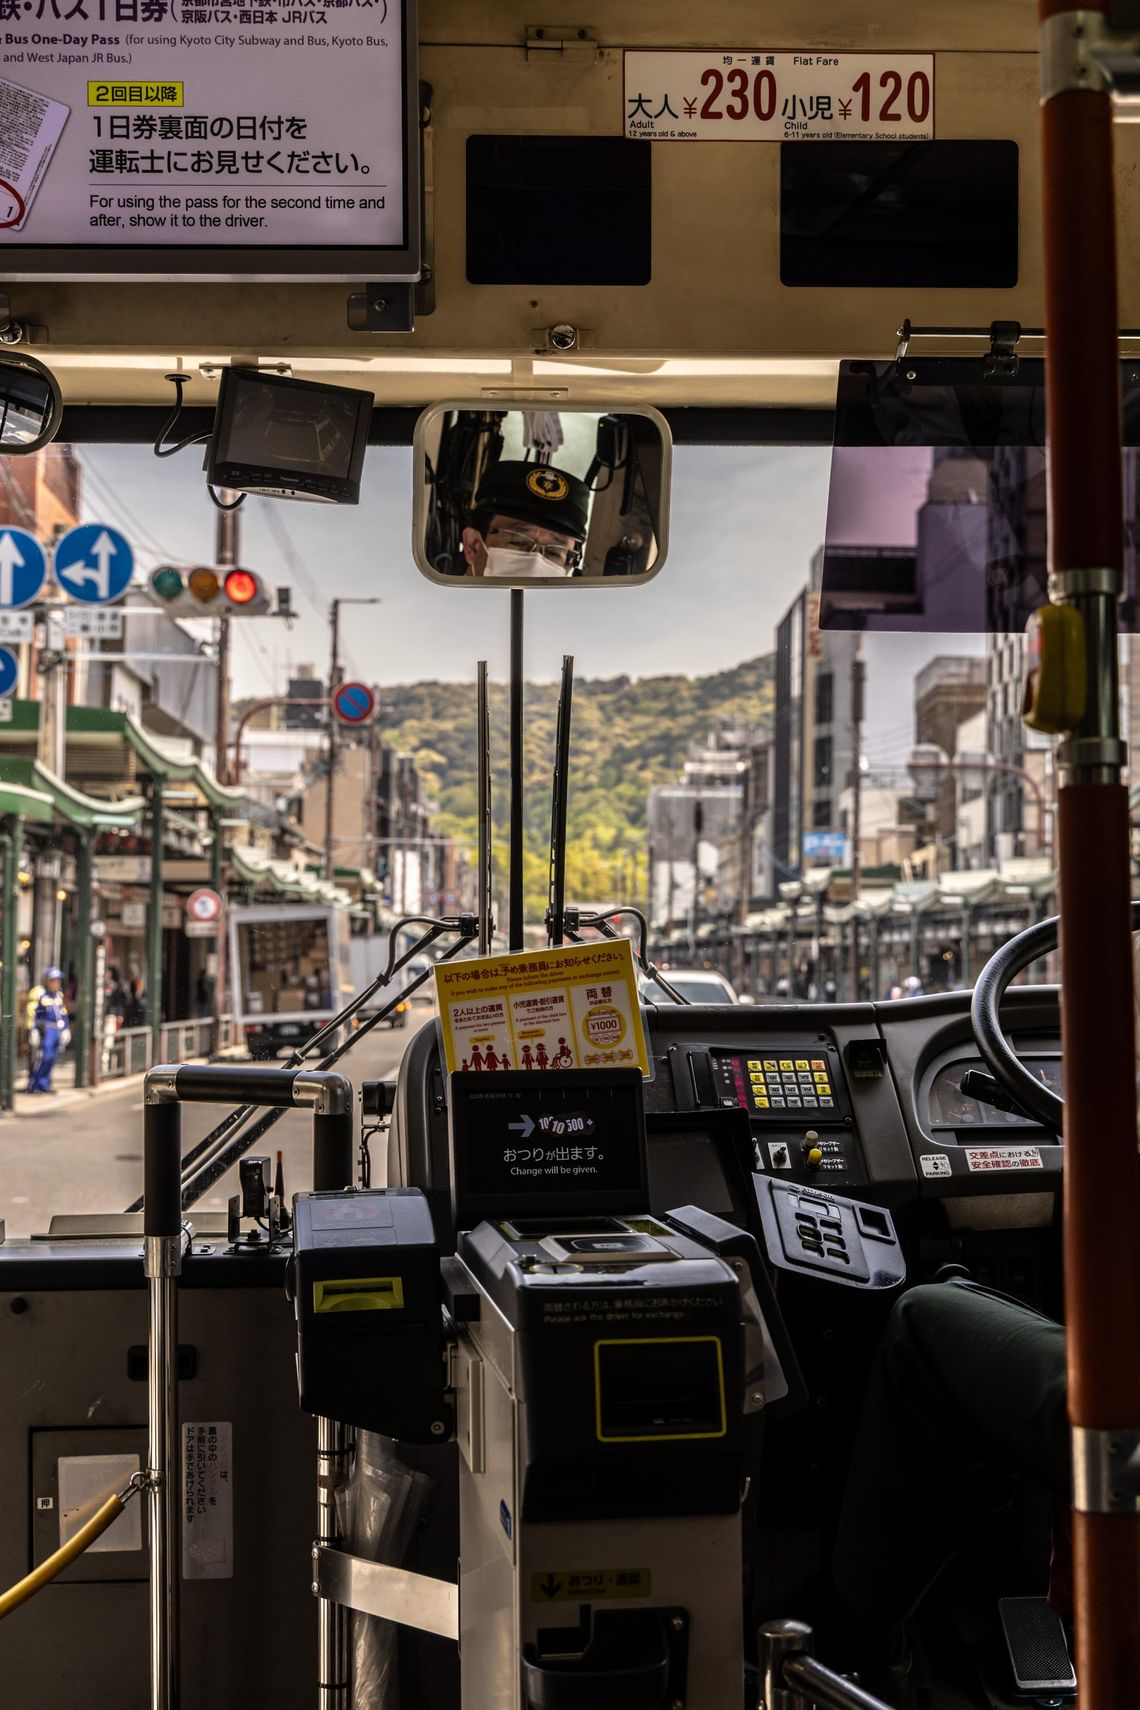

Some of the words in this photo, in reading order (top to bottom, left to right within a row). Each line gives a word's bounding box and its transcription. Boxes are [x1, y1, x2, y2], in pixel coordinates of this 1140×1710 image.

[181, 10, 277, 24] 京阪バス・西日本
[282, 11, 327, 24] JRバス
[5, 34, 28, 45] Bus
[31, 34, 88, 47] One-Day
[91, 34, 120, 45] Pass
[125, 34, 144, 47] (for
[147, 35, 177, 47] using
[180, 35, 212, 47] Kyoto
[214, 35, 235, 47] City
[238, 35, 280, 48] Subway
[283, 35, 305, 46] and
[307, 36, 330, 47] Bus,
[332, 36, 364, 48] Kyoto
[366, 36, 389, 47] Bus,
[3, 52, 24, 63] and
[27, 53, 54, 63] West
[56, 53, 89, 65] Japan
[91, 53, 104, 63] JR
[106, 53, 133, 64] Bus.)
[794, 56, 813, 66] Flat
[816, 56, 839, 66] Fare
[95, 85, 178, 103] 2回目以降
[628, 93, 679, 120] 大人
[781, 94, 833, 120] 小児
[92, 114, 308, 141] 1日券裏面の日付を
[630, 120, 655, 129] Adult
[784, 121, 808, 130] Child
[89, 149, 371, 175] 運転士にお見せください。
[90, 195, 115, 209] For
[117, 195, 155, 213] using
[158, 195, 181, 209] the
[185, 197, 219, 213] pass
[222, 195, 242, 209] for
[245, 195, 267, 209] the
[270, 195, 321, 210] second
[325, 195, 355, 210] time
[359, 195, 385, 210] and
[89, 213, 126, 229] after,
[129, 213, 167, 228] show
[170, 213, 180, 228] it
[182, 214, 195, 228] to
[199, 213, 221, 228] the
[225, 213, 268, 228] driver.
[590, 1019, 618, 1032] ¥1000
[503, 1146, 604, 1162] おつりが出ます。
[510, 1166, 543, 1176] Change
[544, 1165, 559, 1175] will
[561, 1165, 571, 1175] be
[573, 1165, 598, 1176] given.
